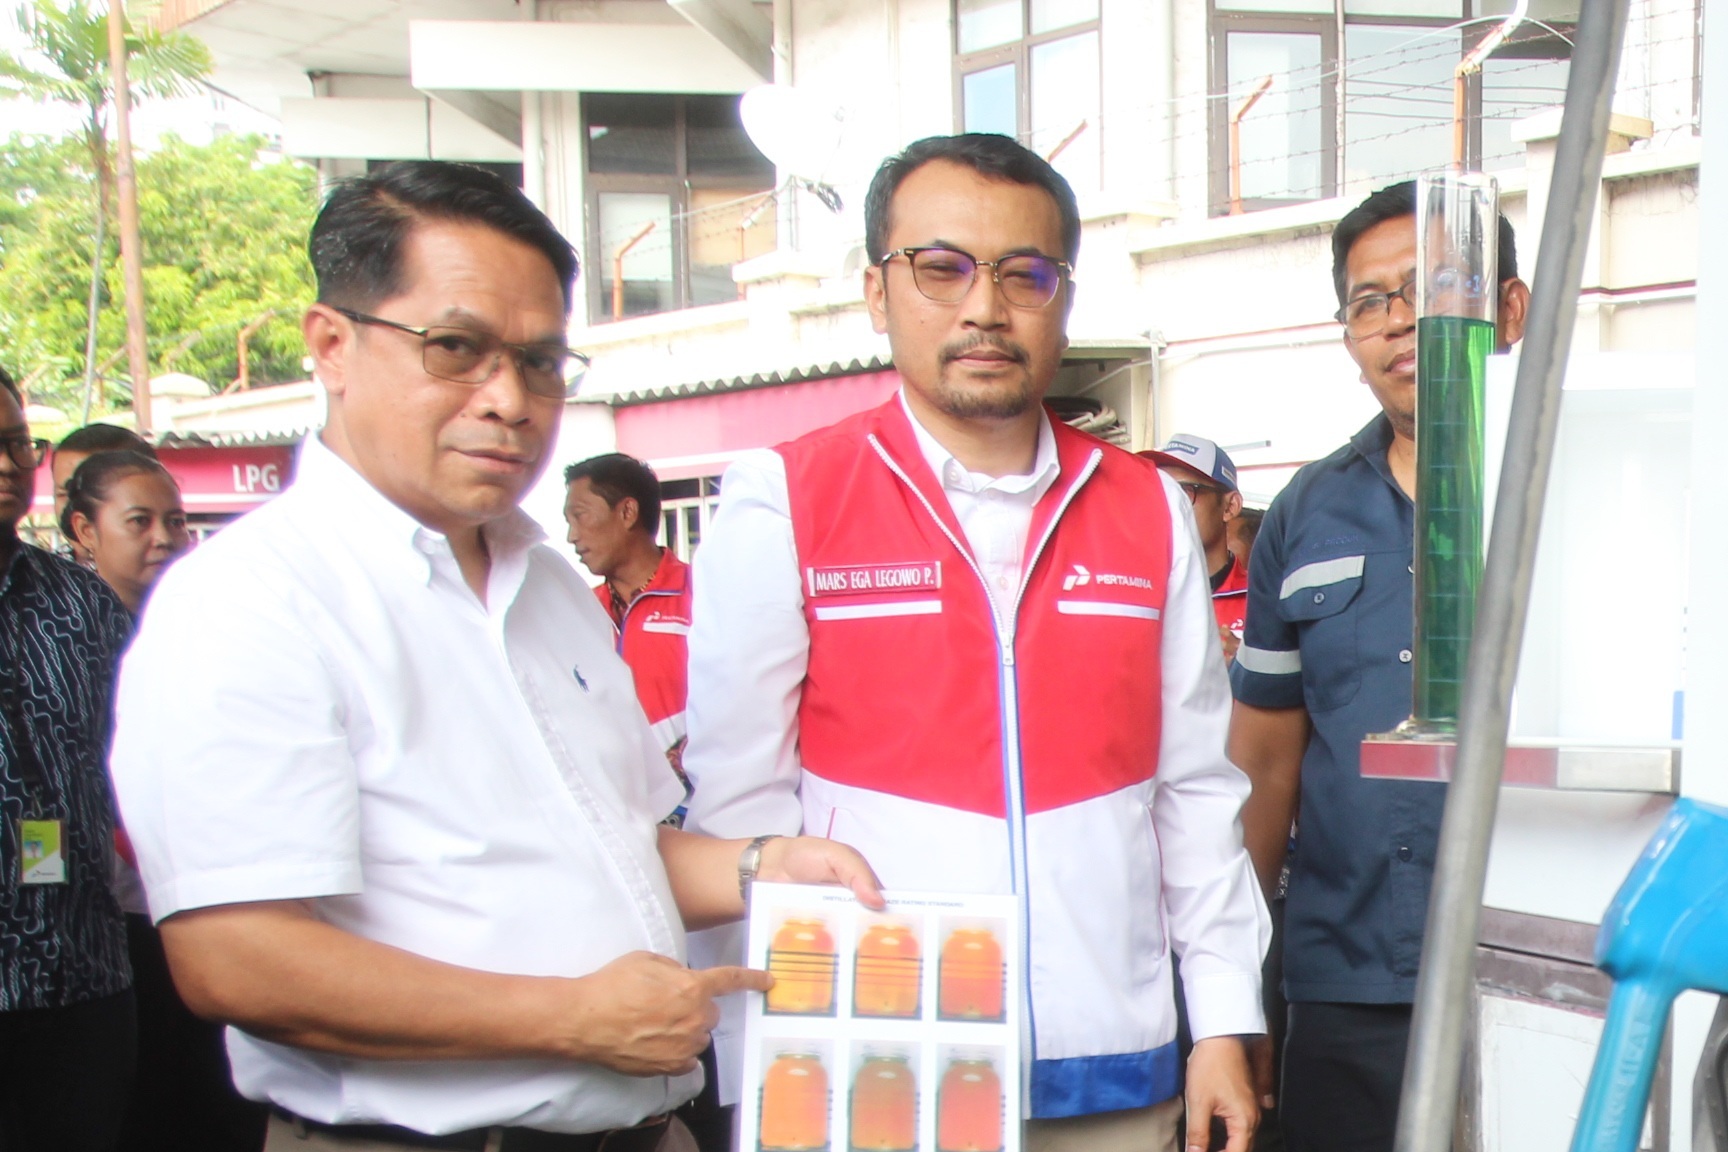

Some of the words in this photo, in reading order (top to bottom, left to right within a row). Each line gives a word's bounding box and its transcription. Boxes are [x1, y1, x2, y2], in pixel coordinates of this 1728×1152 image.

[232, 463, 280, 492] LPG
[816, 572, 848, 591] MARS
[851, 570, 872, 589] EGA
[875, 568, 921, 587] LEGOWO
[924, 567, 934, 585] P.
[1096, 573, 1152, 591] PERTAMINA
